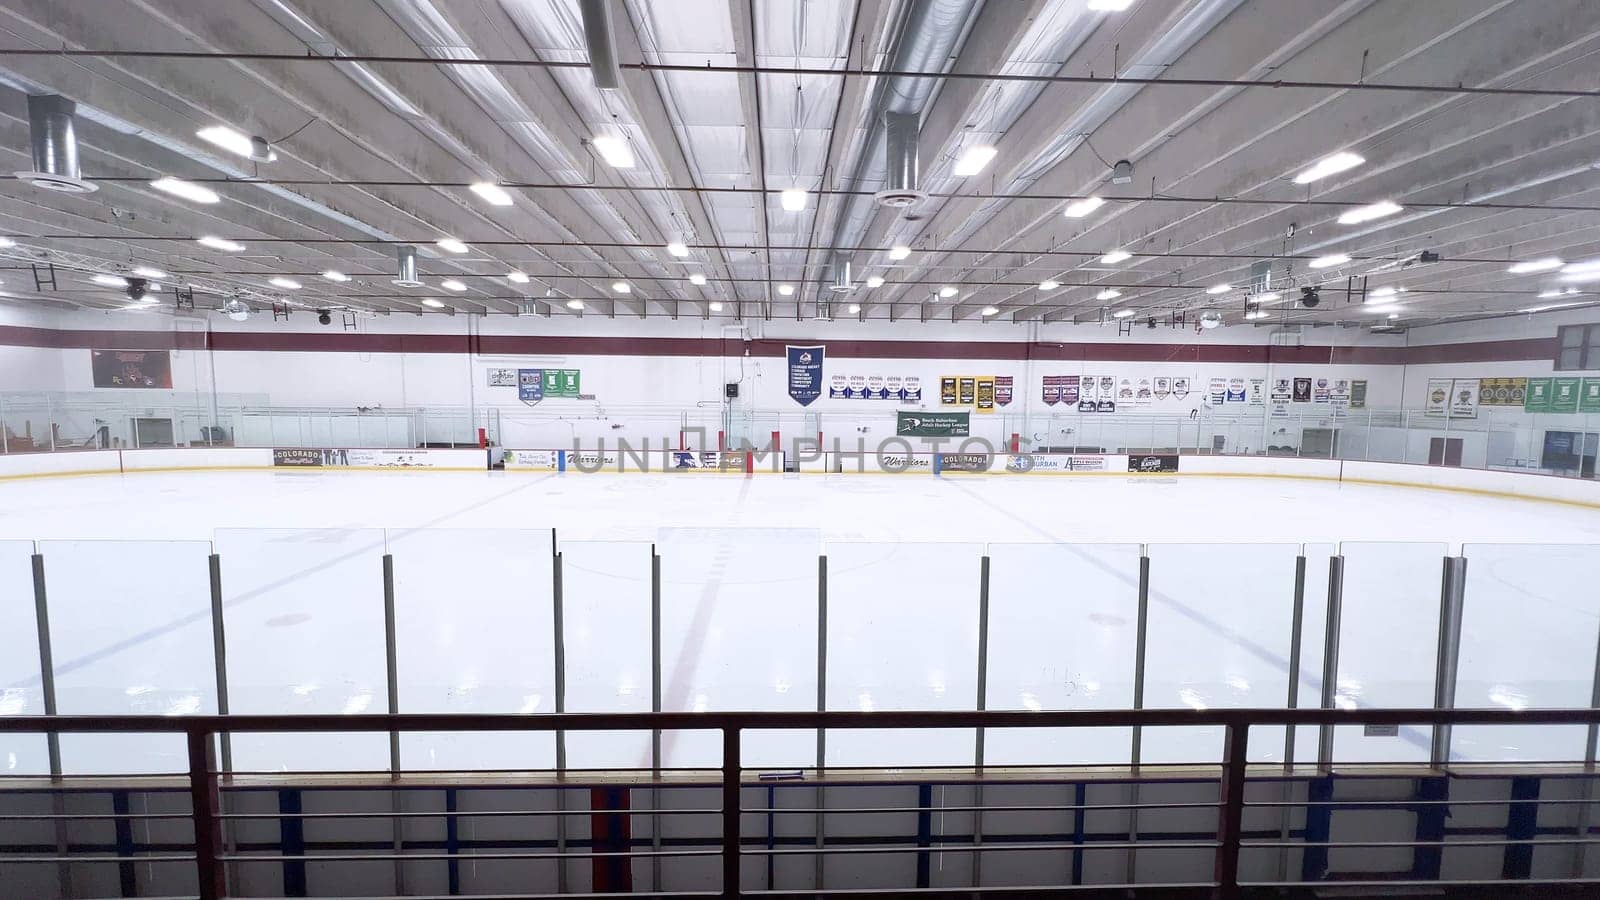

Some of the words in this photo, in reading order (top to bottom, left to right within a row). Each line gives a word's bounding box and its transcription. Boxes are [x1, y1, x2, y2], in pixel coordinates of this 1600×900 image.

[277, 450, 319, 459] COLORADO
[567, 453, 615, 464] Warriors
[883, 456, 929, 467] Warriors
[944, 456, 983, 464] COLORADO
